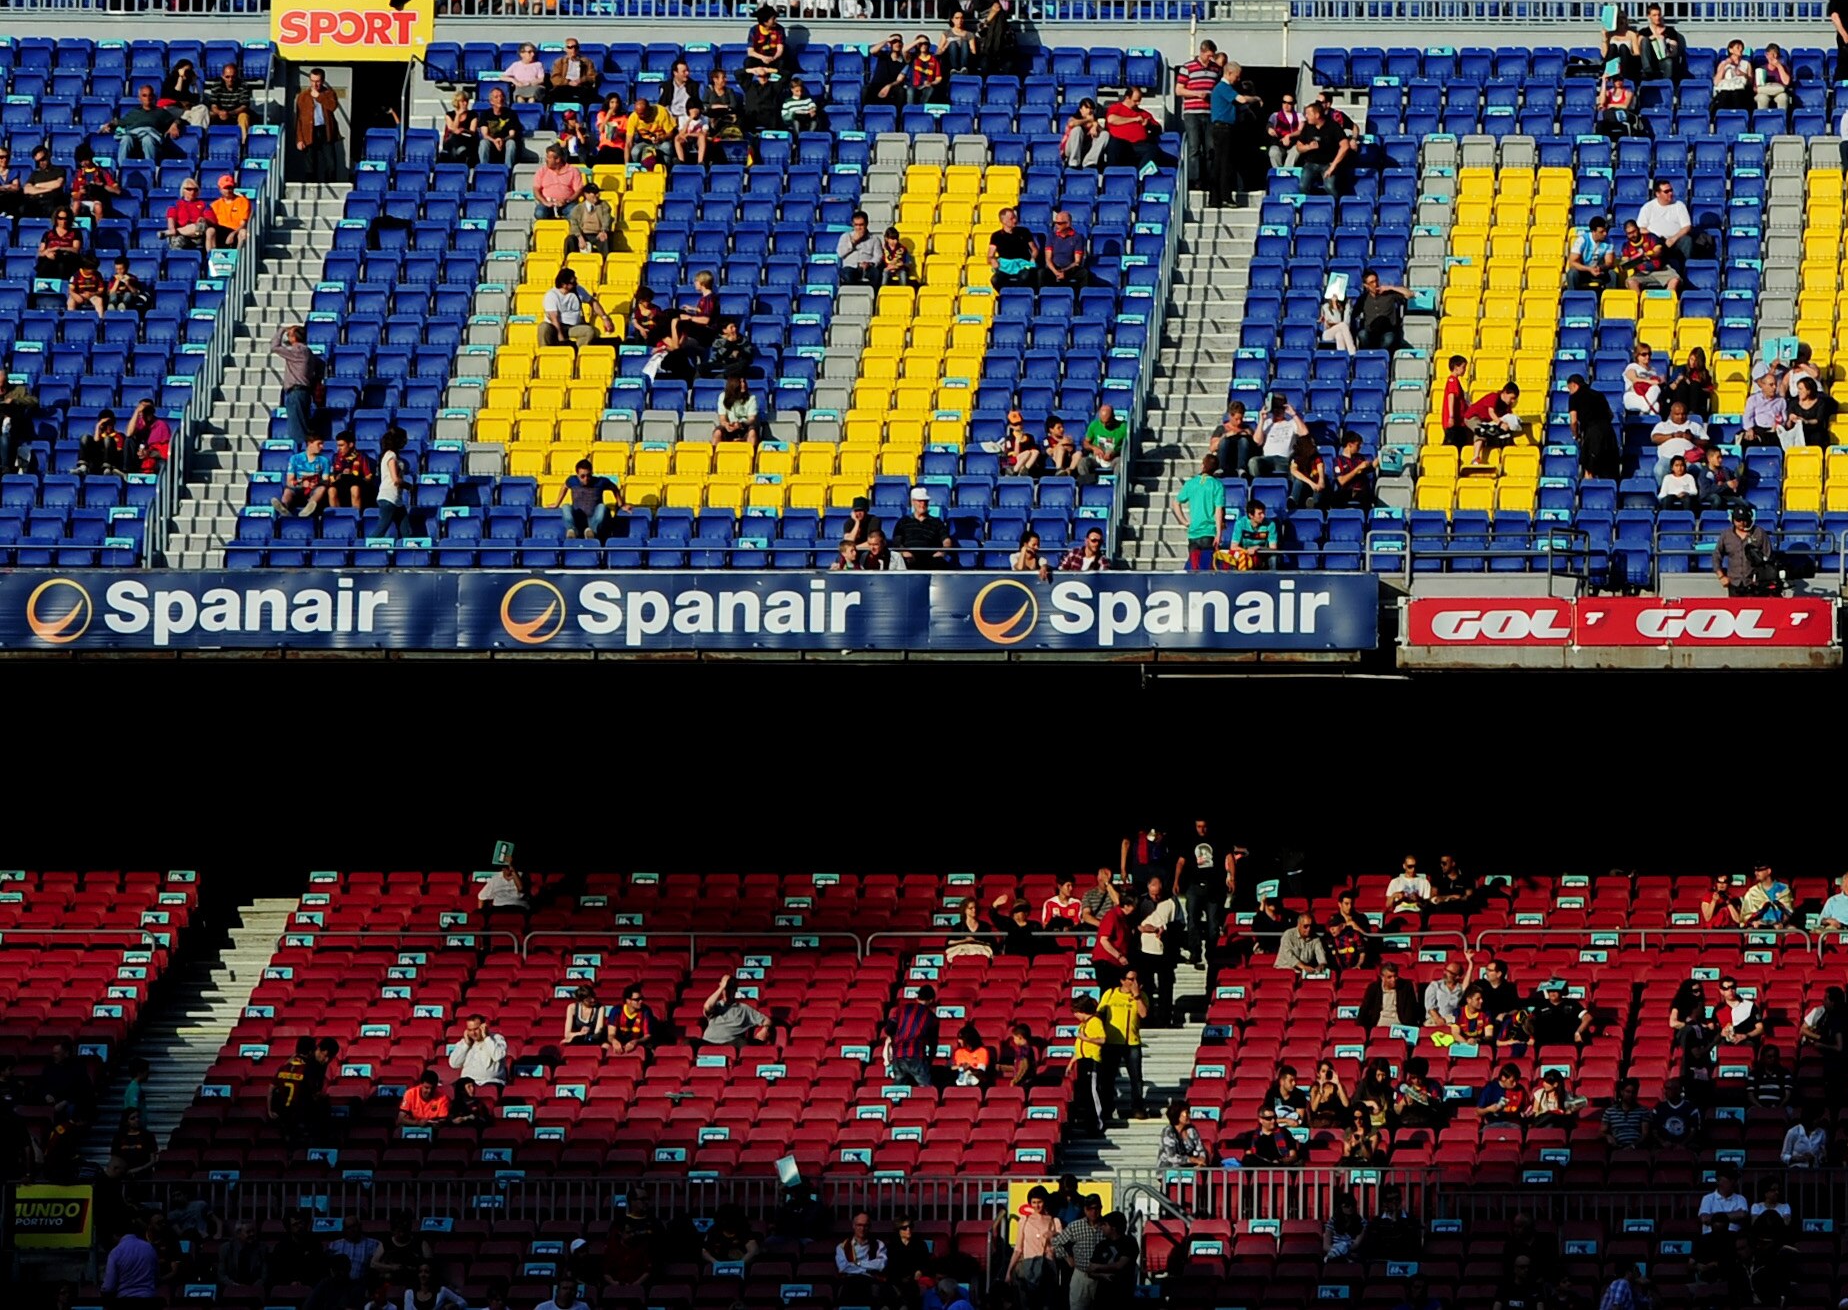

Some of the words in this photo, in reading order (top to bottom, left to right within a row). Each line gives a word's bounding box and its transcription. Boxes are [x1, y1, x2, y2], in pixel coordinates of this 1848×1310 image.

[279, 10, 417, 45] SPORT
[104, 578, 389, 646] Spanair
[577, 579, 862, 646] Spanair
[1049, 579, 1330, 646] Spanair
[1431, 609, 1572, 640] GOL
[1636, 608, 1776, 639] GOL
[283, 1081, 295, 1108] 7
